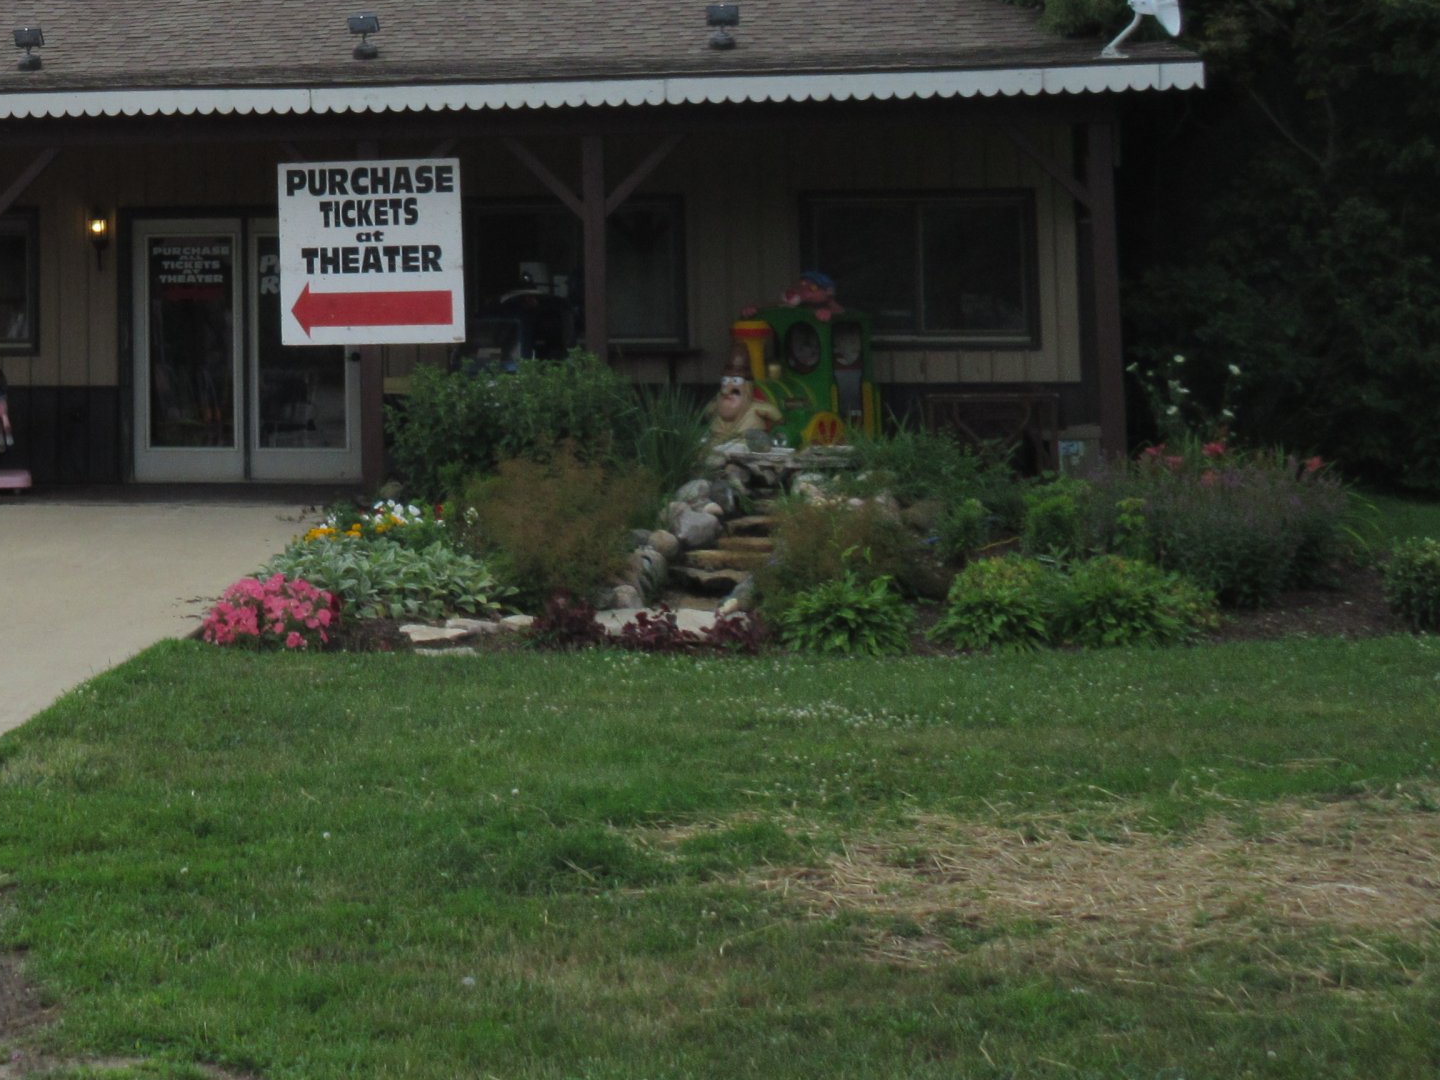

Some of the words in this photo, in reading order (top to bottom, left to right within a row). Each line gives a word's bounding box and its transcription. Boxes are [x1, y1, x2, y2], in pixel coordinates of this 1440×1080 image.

[286, 165, 454, 197] PURCHASE
[319, 198, 419, 228] TICKETS
[356, 230, 384, 243] at
[152, 246, 230, 256] PURCHASE
[161, 260, 221, 270] TICKETS
[301, 244, 443, 275] THEATER
[158, 274, 224, 284] THEATER
